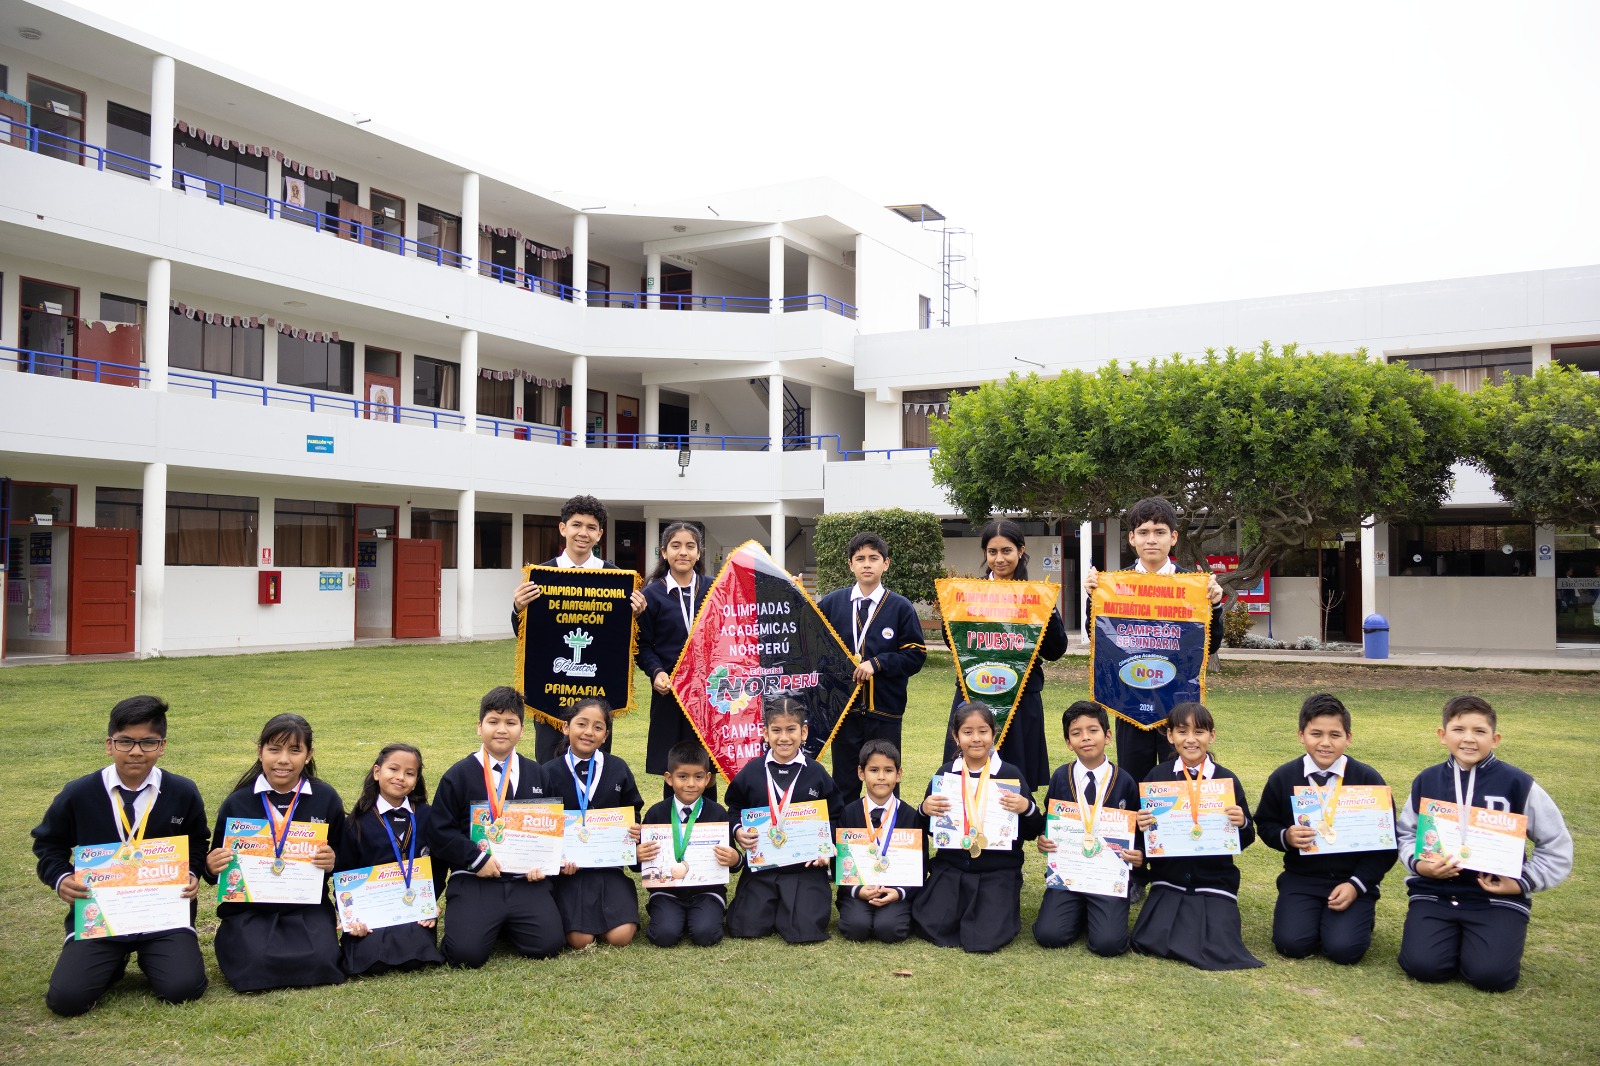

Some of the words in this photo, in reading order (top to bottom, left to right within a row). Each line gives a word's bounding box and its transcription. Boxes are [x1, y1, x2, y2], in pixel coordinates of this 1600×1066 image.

[538, 585, 582, 597] OLIMPIADA
[584, 588, 626, 598] NACIONAL
[1115, 583, 1136, 596] RALLY
[1138, 584, 1174, 599] NACIONAL
[1176, 587, 1186, 599] DE
[956, 592, 1000, 603] OLIMPIADA
[1002, 594, 1041, 605] NACIONAL
[548, 600, 560, 610] DE
[562, 600, 612, 612] MATEMÁTICA
[722, 601, 790, 618] OLIMPIADAS
[967, 606, 978, 616] DE
[1104, 602, 1151, 616] MATEMÁTICA
[556, 612, 604, 624] CAMPEÓN
[720, 620, 796, 636] ACADÉMICAS
[1117, 624, 1180, 638] CAMPEÓN
[730, 638, 790, 656] NORPERÚ
[977, 632, 1024, 651] PUESTO
[1116, 636, 1180, 650] SECUNDARIA
[553, 657, 597, 673] Talentos
[750, 666, 784, 676] Editorial
[982, 674, 1006, 685] NOR
[1136, 668, 1164, 678] NOR
[544, 683, 606, 696] PRIMARIA
[716, 671, 819, 702] NORPERÚ
[558, 697, 580, 707] 20
[1140, 704, 1154, 712] 2024
[722, 723, 764, 738] CAMPE
[586, 814, 624, 823] Aritmética
[784, 808, 817, 818] ritmética
[1477, 810, 1517, 829] Rally
[523, 814, 556, 830] Rally
[287, 829, 316, 838] mética
[892, 832, 914, 844] ally
[142, 845, 174, 855] mética
[285, 841, 318, 855] Rally
[138, 865, 179, 879] Rally
